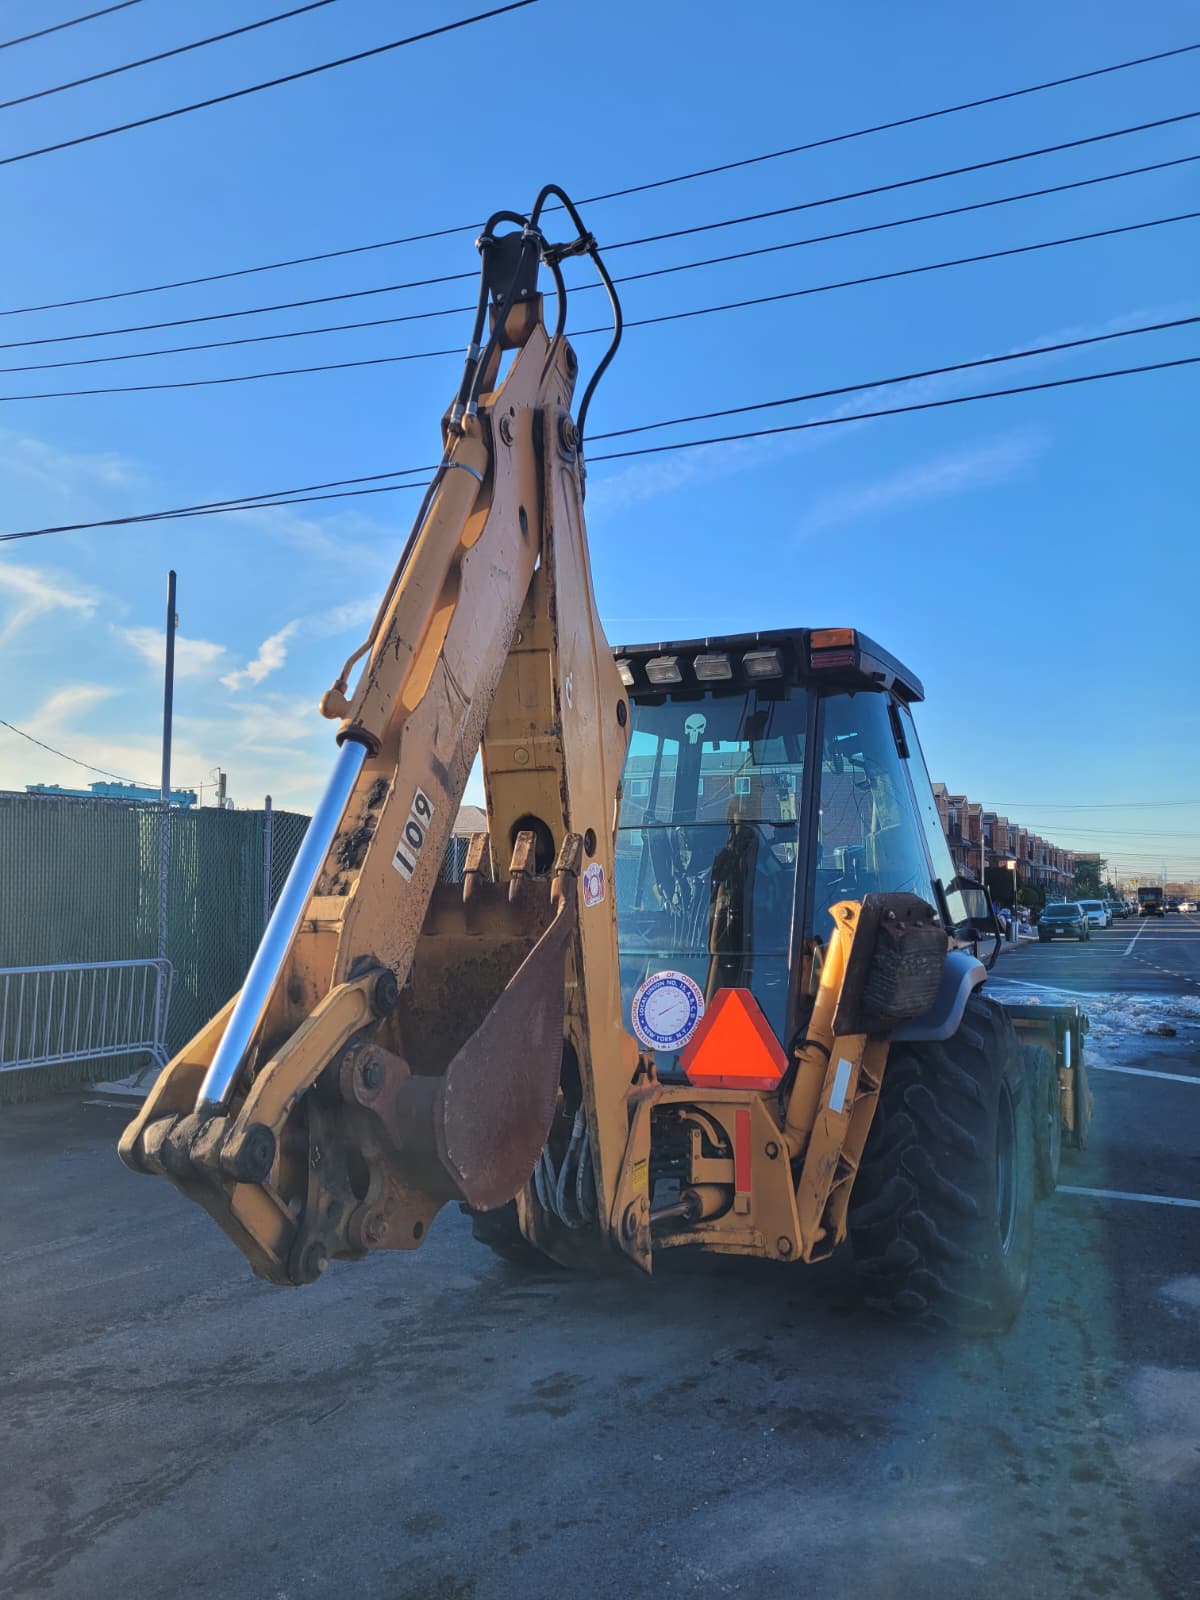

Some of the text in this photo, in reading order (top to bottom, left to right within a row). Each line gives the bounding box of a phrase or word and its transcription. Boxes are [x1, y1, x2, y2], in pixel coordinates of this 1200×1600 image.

[639, 996, 648, 1016] LOCAL
[646, 981, 665, 996] UNION
[640, 976, 660, 992] UNION
[681, 975, 704, 1007] OPERATING
[643, 1026, 655, 1037] NEW
